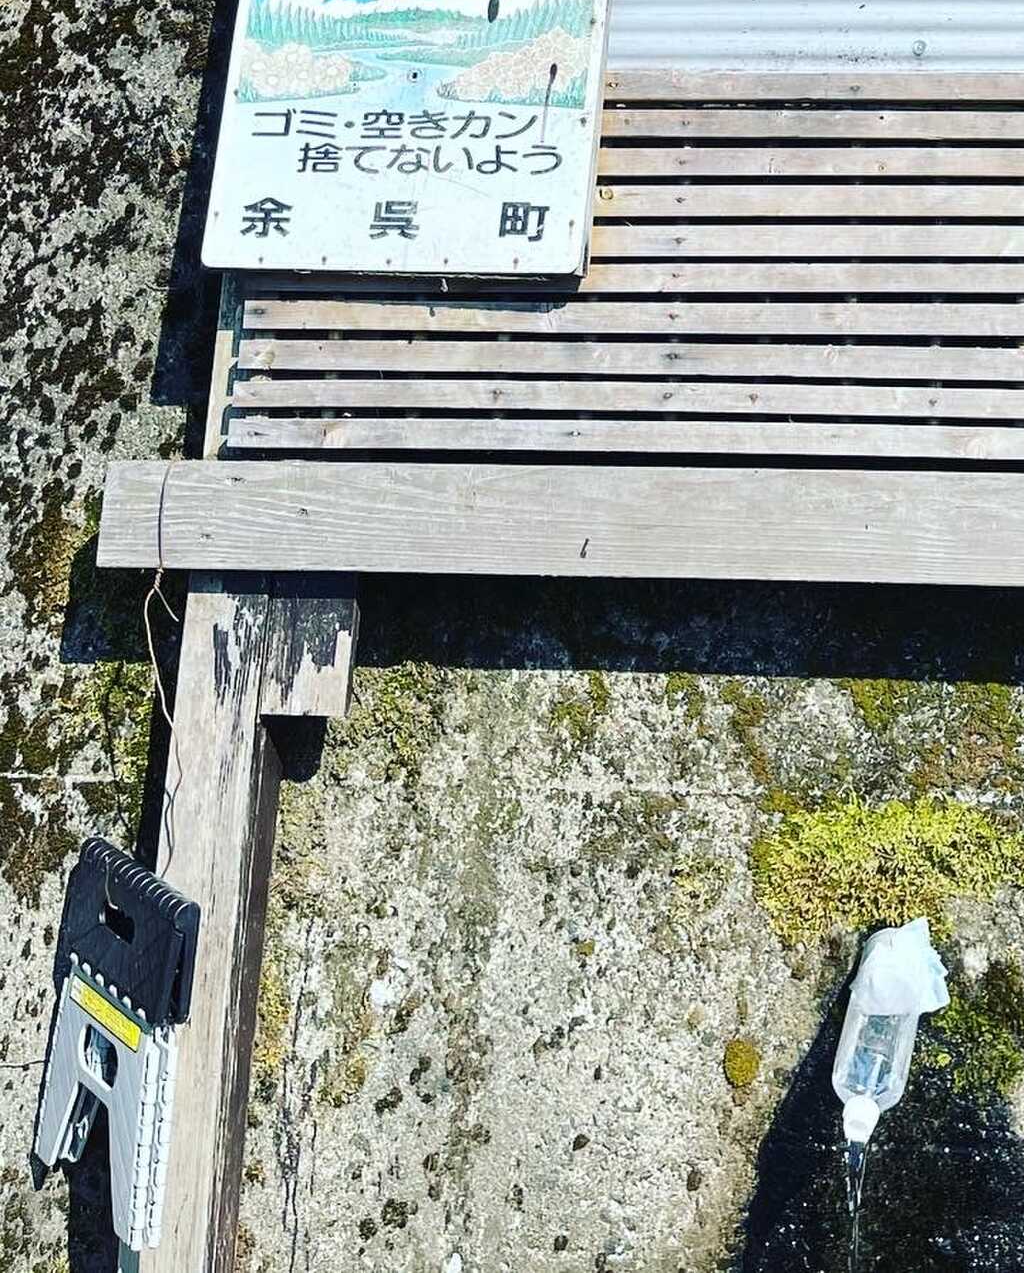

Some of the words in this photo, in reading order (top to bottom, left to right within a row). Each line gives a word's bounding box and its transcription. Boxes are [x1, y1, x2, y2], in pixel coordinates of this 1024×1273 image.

[252, 108, 538, 139] ゴミ・空きカン
[297, 143, 563, 175] 捨てないよう
[240, 197, 551, 242] 余呉町
